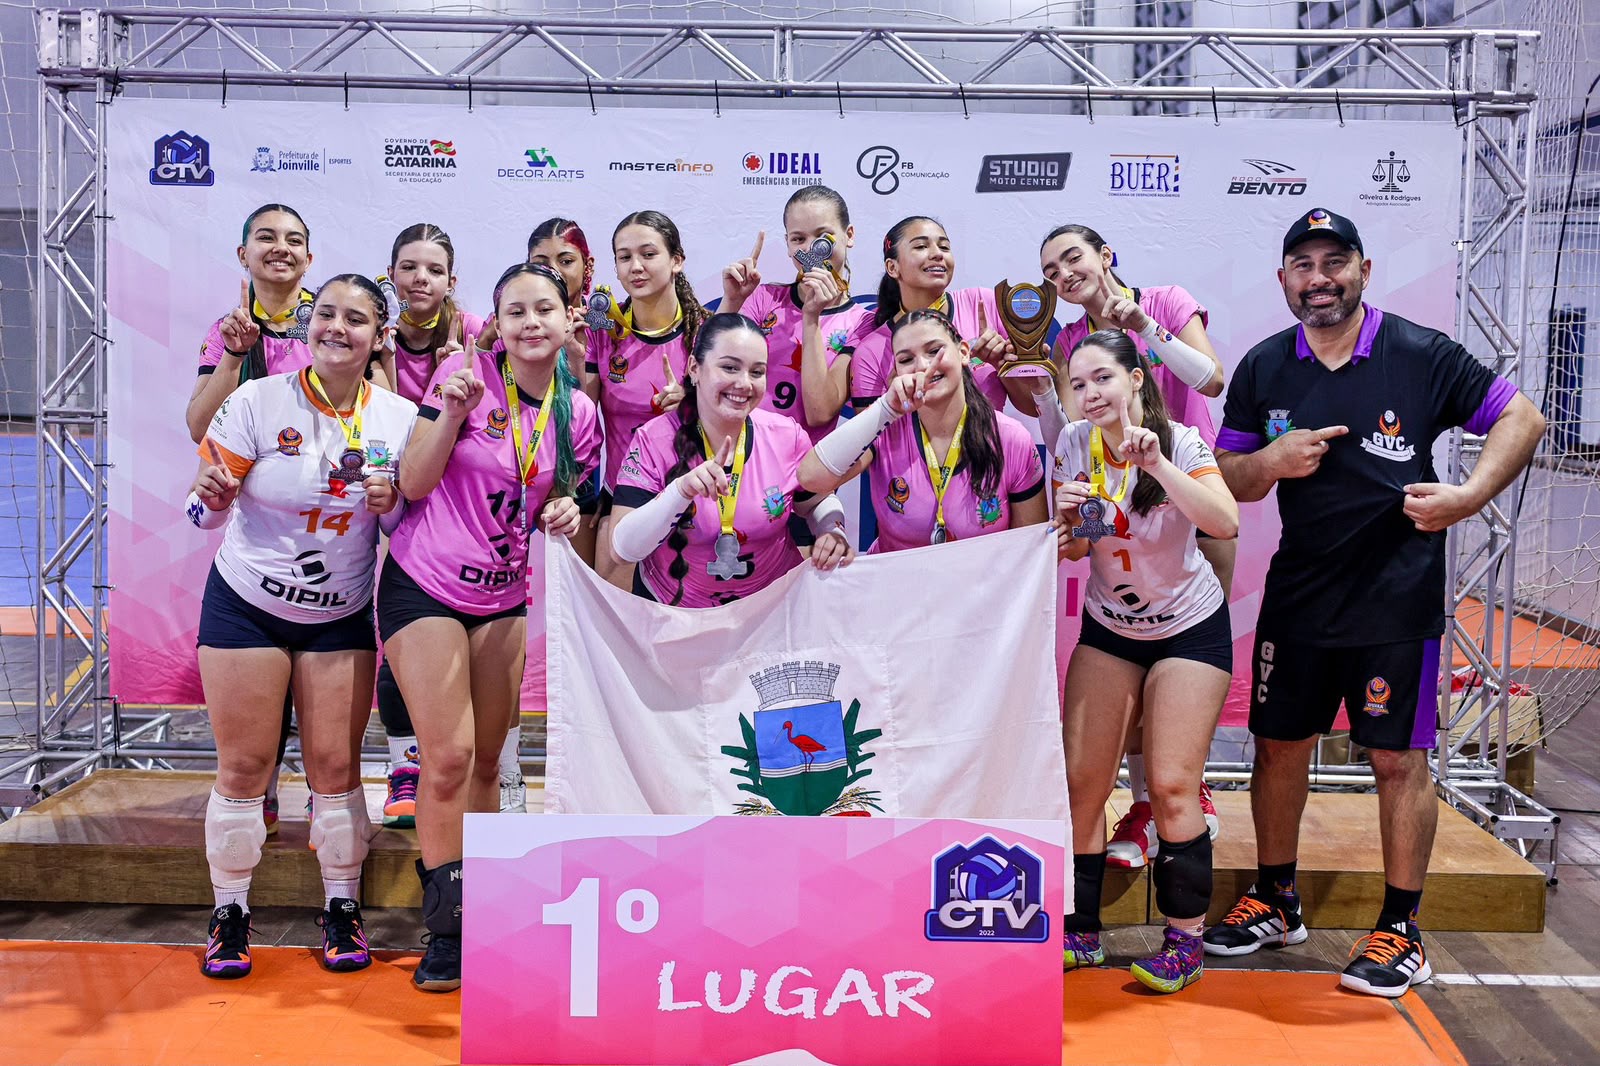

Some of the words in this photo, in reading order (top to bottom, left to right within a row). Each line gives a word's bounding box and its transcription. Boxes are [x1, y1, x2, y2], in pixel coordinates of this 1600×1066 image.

[279, 150, 309, 160] Prefeitura
[311, 151, 319, 160] de
[384, 145, 432, 156] SANTA
[278, 160, 320, 171] Joinville
[384, 156, 457, 169] CATARINA
[769, 152, 822, 174] IDEAL
[901, 161, 914, 170] FB
[989, 160, 1059, 177] STUDIO
[157, 163, 210, 179] CTV
[497, 168, 544, 178] DECOR
[547, 169, 585, 179] ARTS
[901, 171, 950, 179] COMUNICAÇÃO
[742, 175, 790, 186] EMERGÊNCIAS
[791, 176, 823, 186] MÉDICAS
[989, 177, 1017, 185] MOTO
[1020, 178, 1058, 186] CENTER
[1227, 182, 1307, 196] BENTO
[1390, 194, 1421, 202] Rodrigues
[772, 381, 797, 410] 9
[1372, 431, 1406, 451] GVC
[487, 490, 521, 524] 11
[299, 507, 354, 537] 14
[1074, 526, 1115, 534] JOINVILLE
[1112, 549, 1132, 573] 1
[260, 576, 347, 607] DIPIL
[1256, 640, 1275, 704] GVC
[936, 899, 1041, 930] CTV
[978, 929, 996, 937] 2022
[657, 960, 935, 1019] LUGAR
